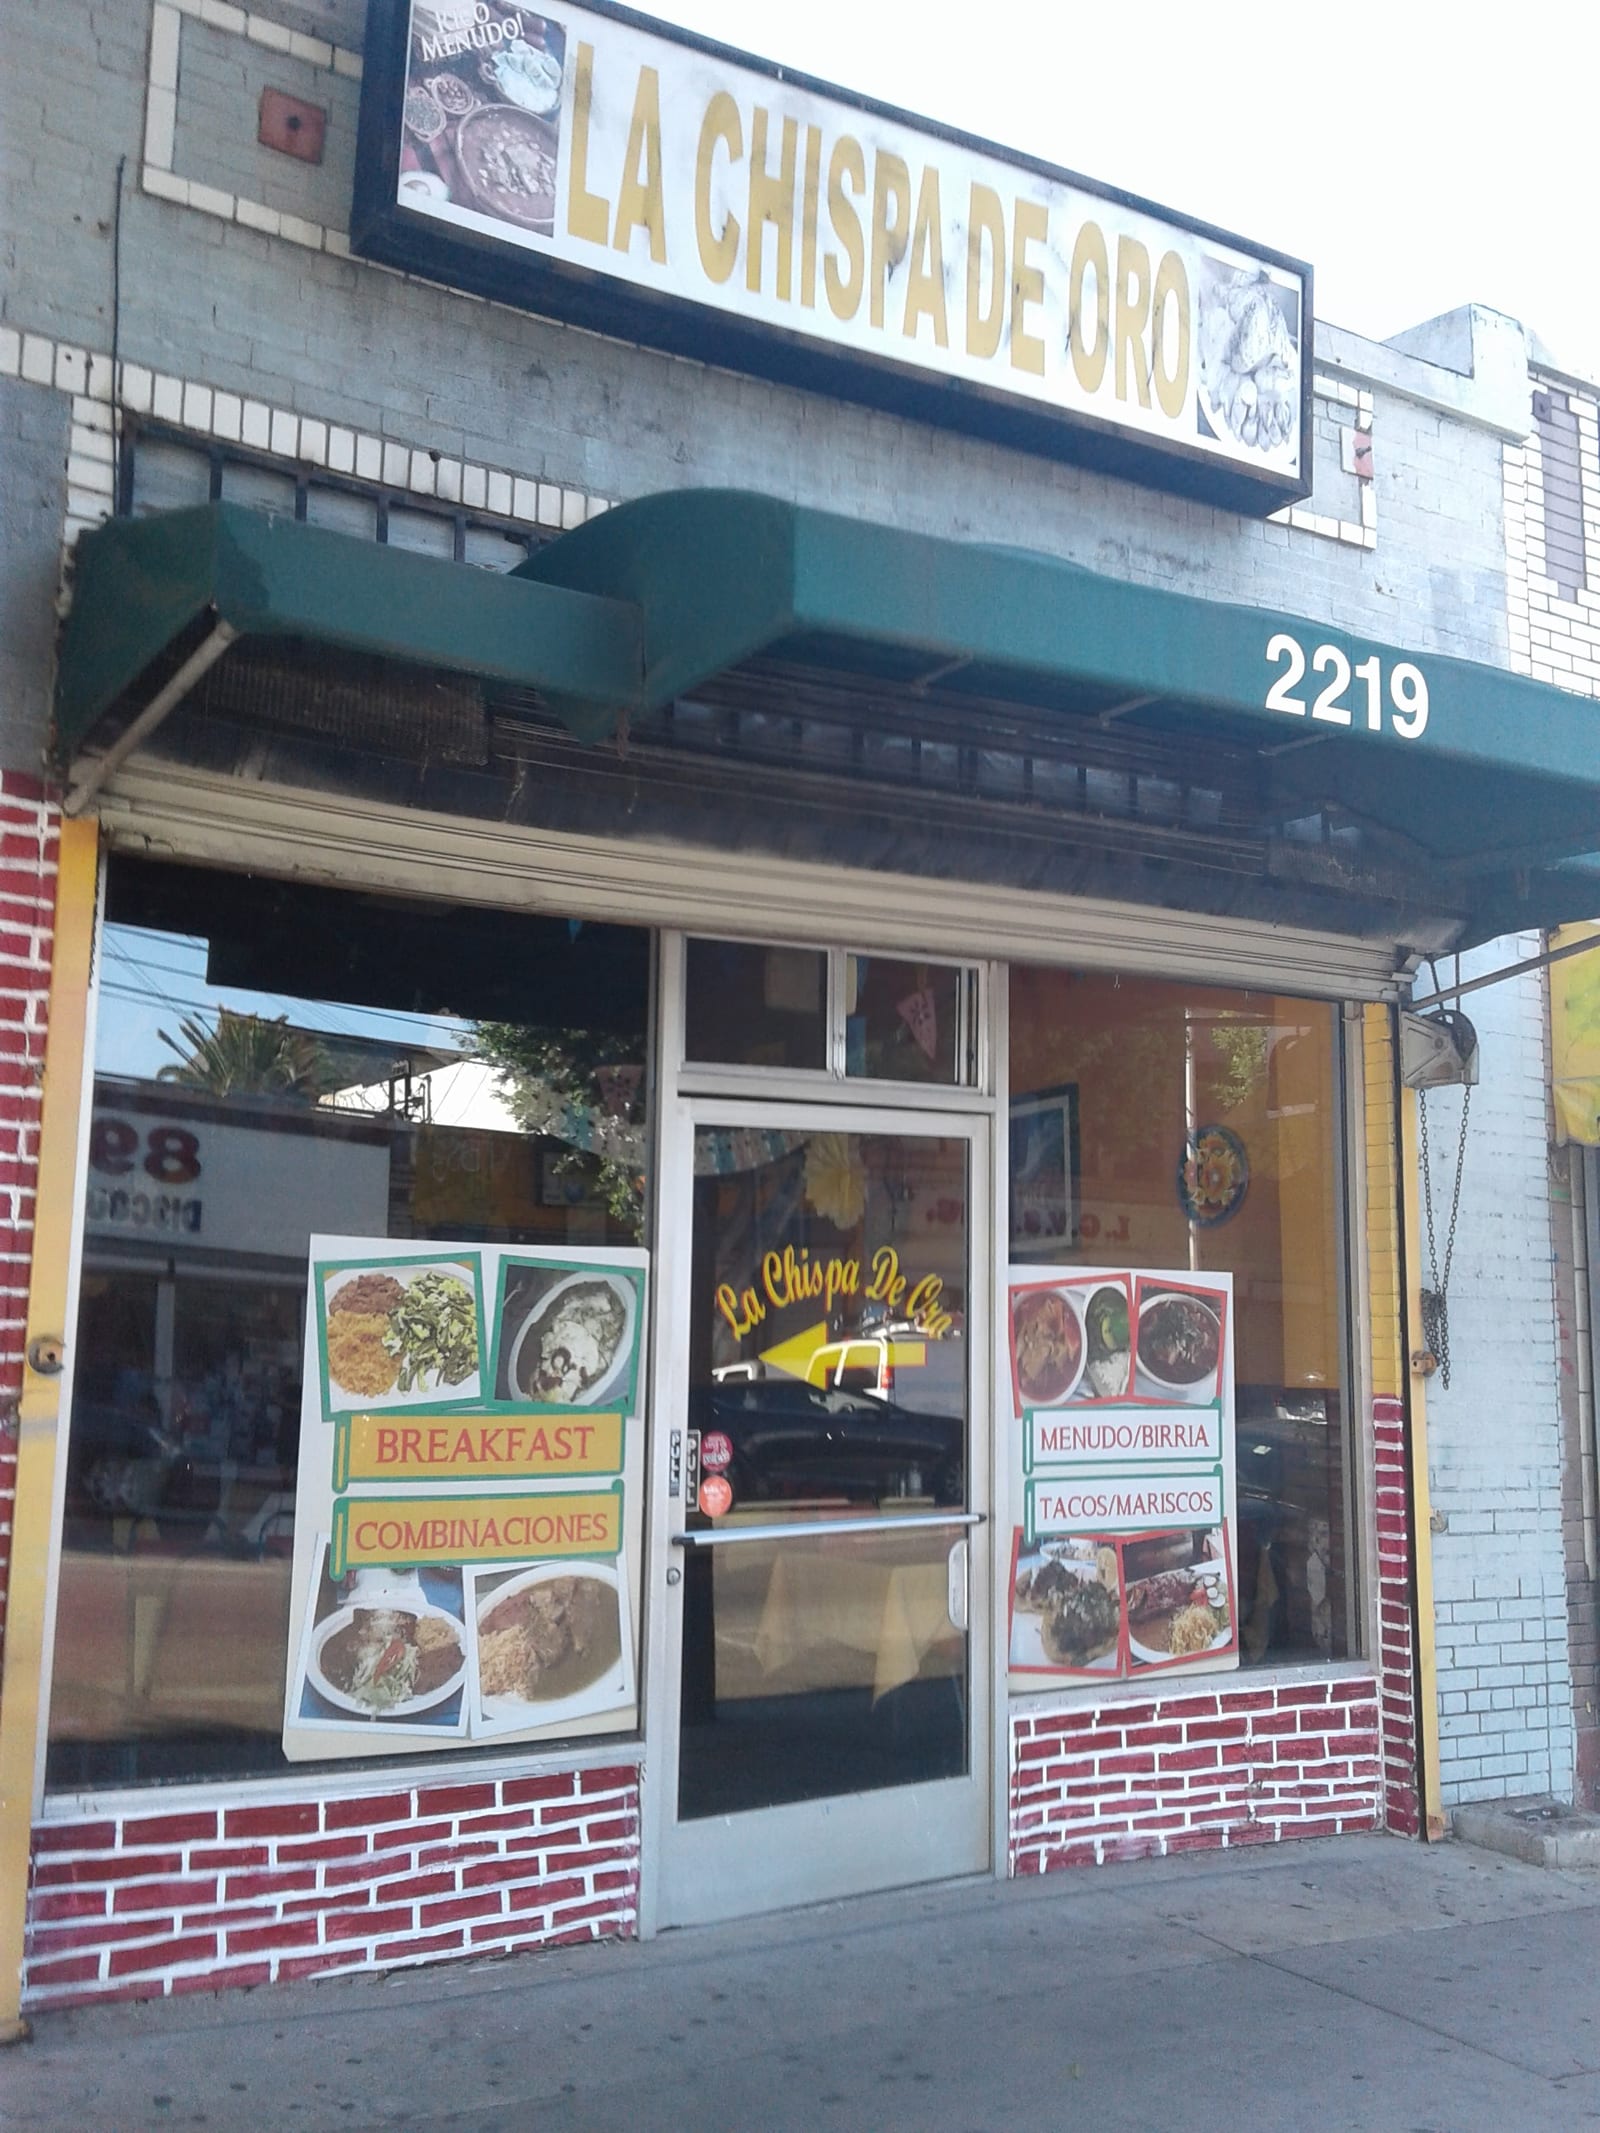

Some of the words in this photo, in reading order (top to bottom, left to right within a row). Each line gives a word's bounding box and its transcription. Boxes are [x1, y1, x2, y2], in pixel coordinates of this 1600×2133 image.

[421, 12, 525, 62] MENUDO!
[567, 41, 667, 265] LA
[695, 90, 950, 349] CHISPA
[966, 182, 1049, 377] DE
[1069, 220, 1191, 419] ORO
[1265, 633, 1429, 739] 2219
[716, 1283, 766, 1342] La
[762, 1243, 860, 1313] Chispa
[865, 1245, 908, 1307] De
[375, 1426, 595, 1464] BREAKFAST
[670, 1432, 681, 1483] PULL
[1040, 1424, 1210, 1451] MENUDO/BIRRIA
[686, 1437, 697, 1505] PULL
[1040, 1491, 1213, 1520] TACOS/MARISCOS
[354, 1513, 609, 1552] COMBINACIONES
